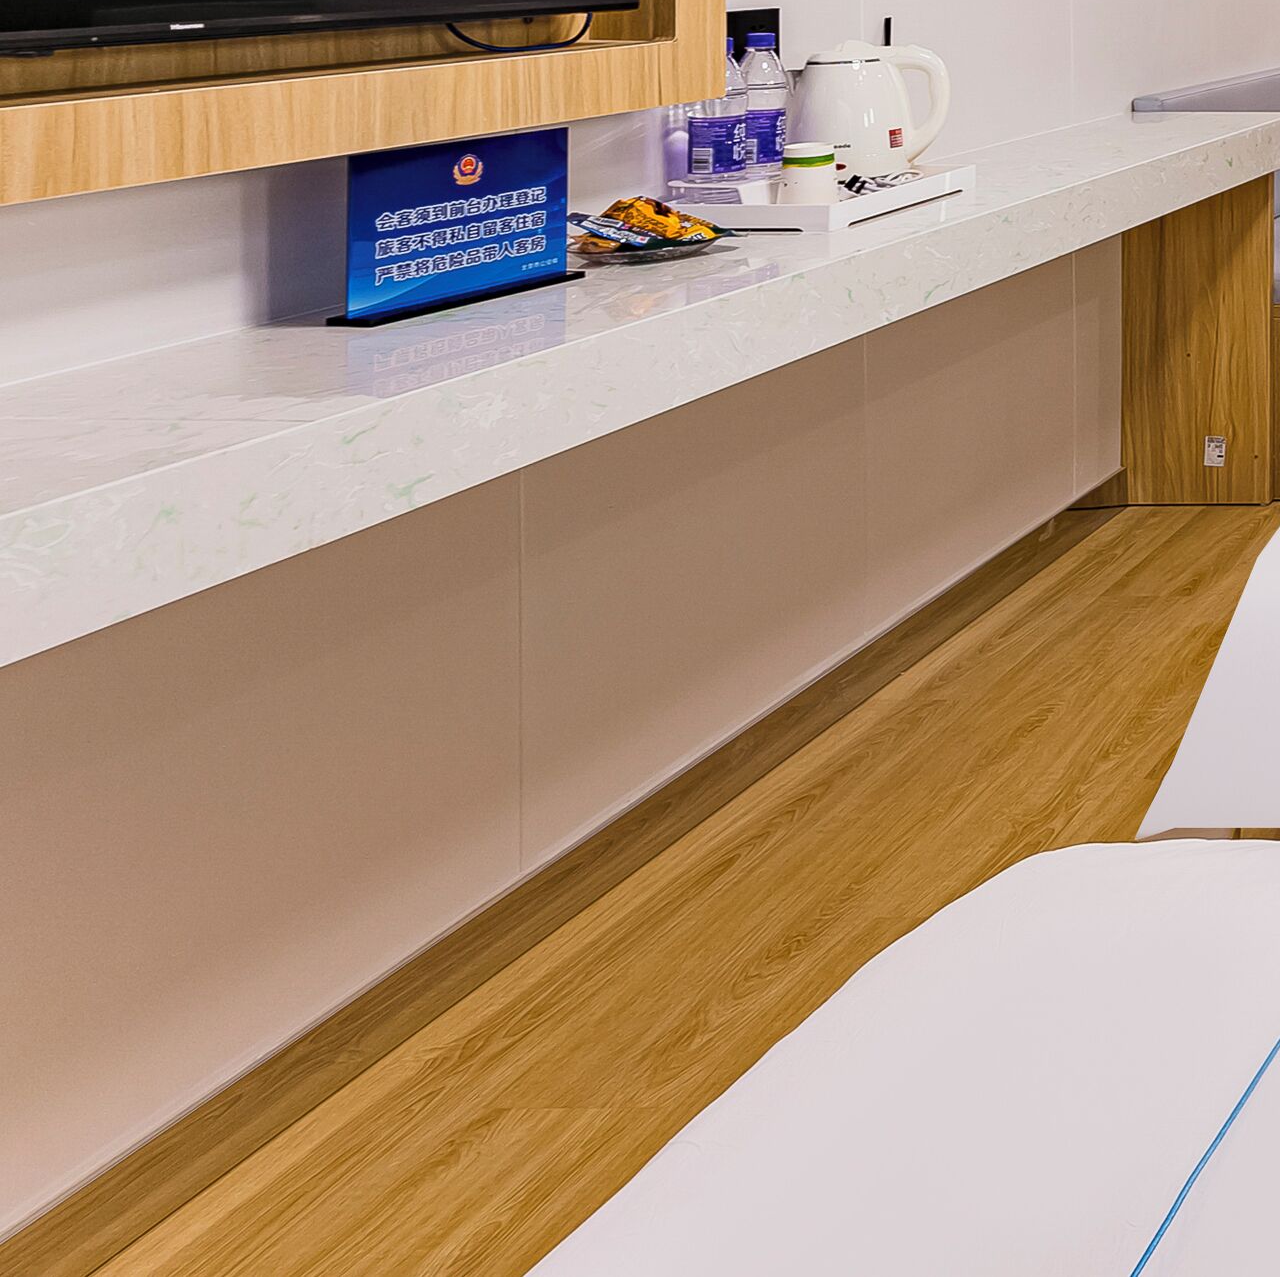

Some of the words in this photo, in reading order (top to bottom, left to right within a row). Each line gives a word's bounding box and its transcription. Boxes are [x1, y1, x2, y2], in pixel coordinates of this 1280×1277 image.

[375, 186, 547, 232] 会客须到前台办理登记
[375, 210, 547, 260] 旅客不得私自留客住宿
